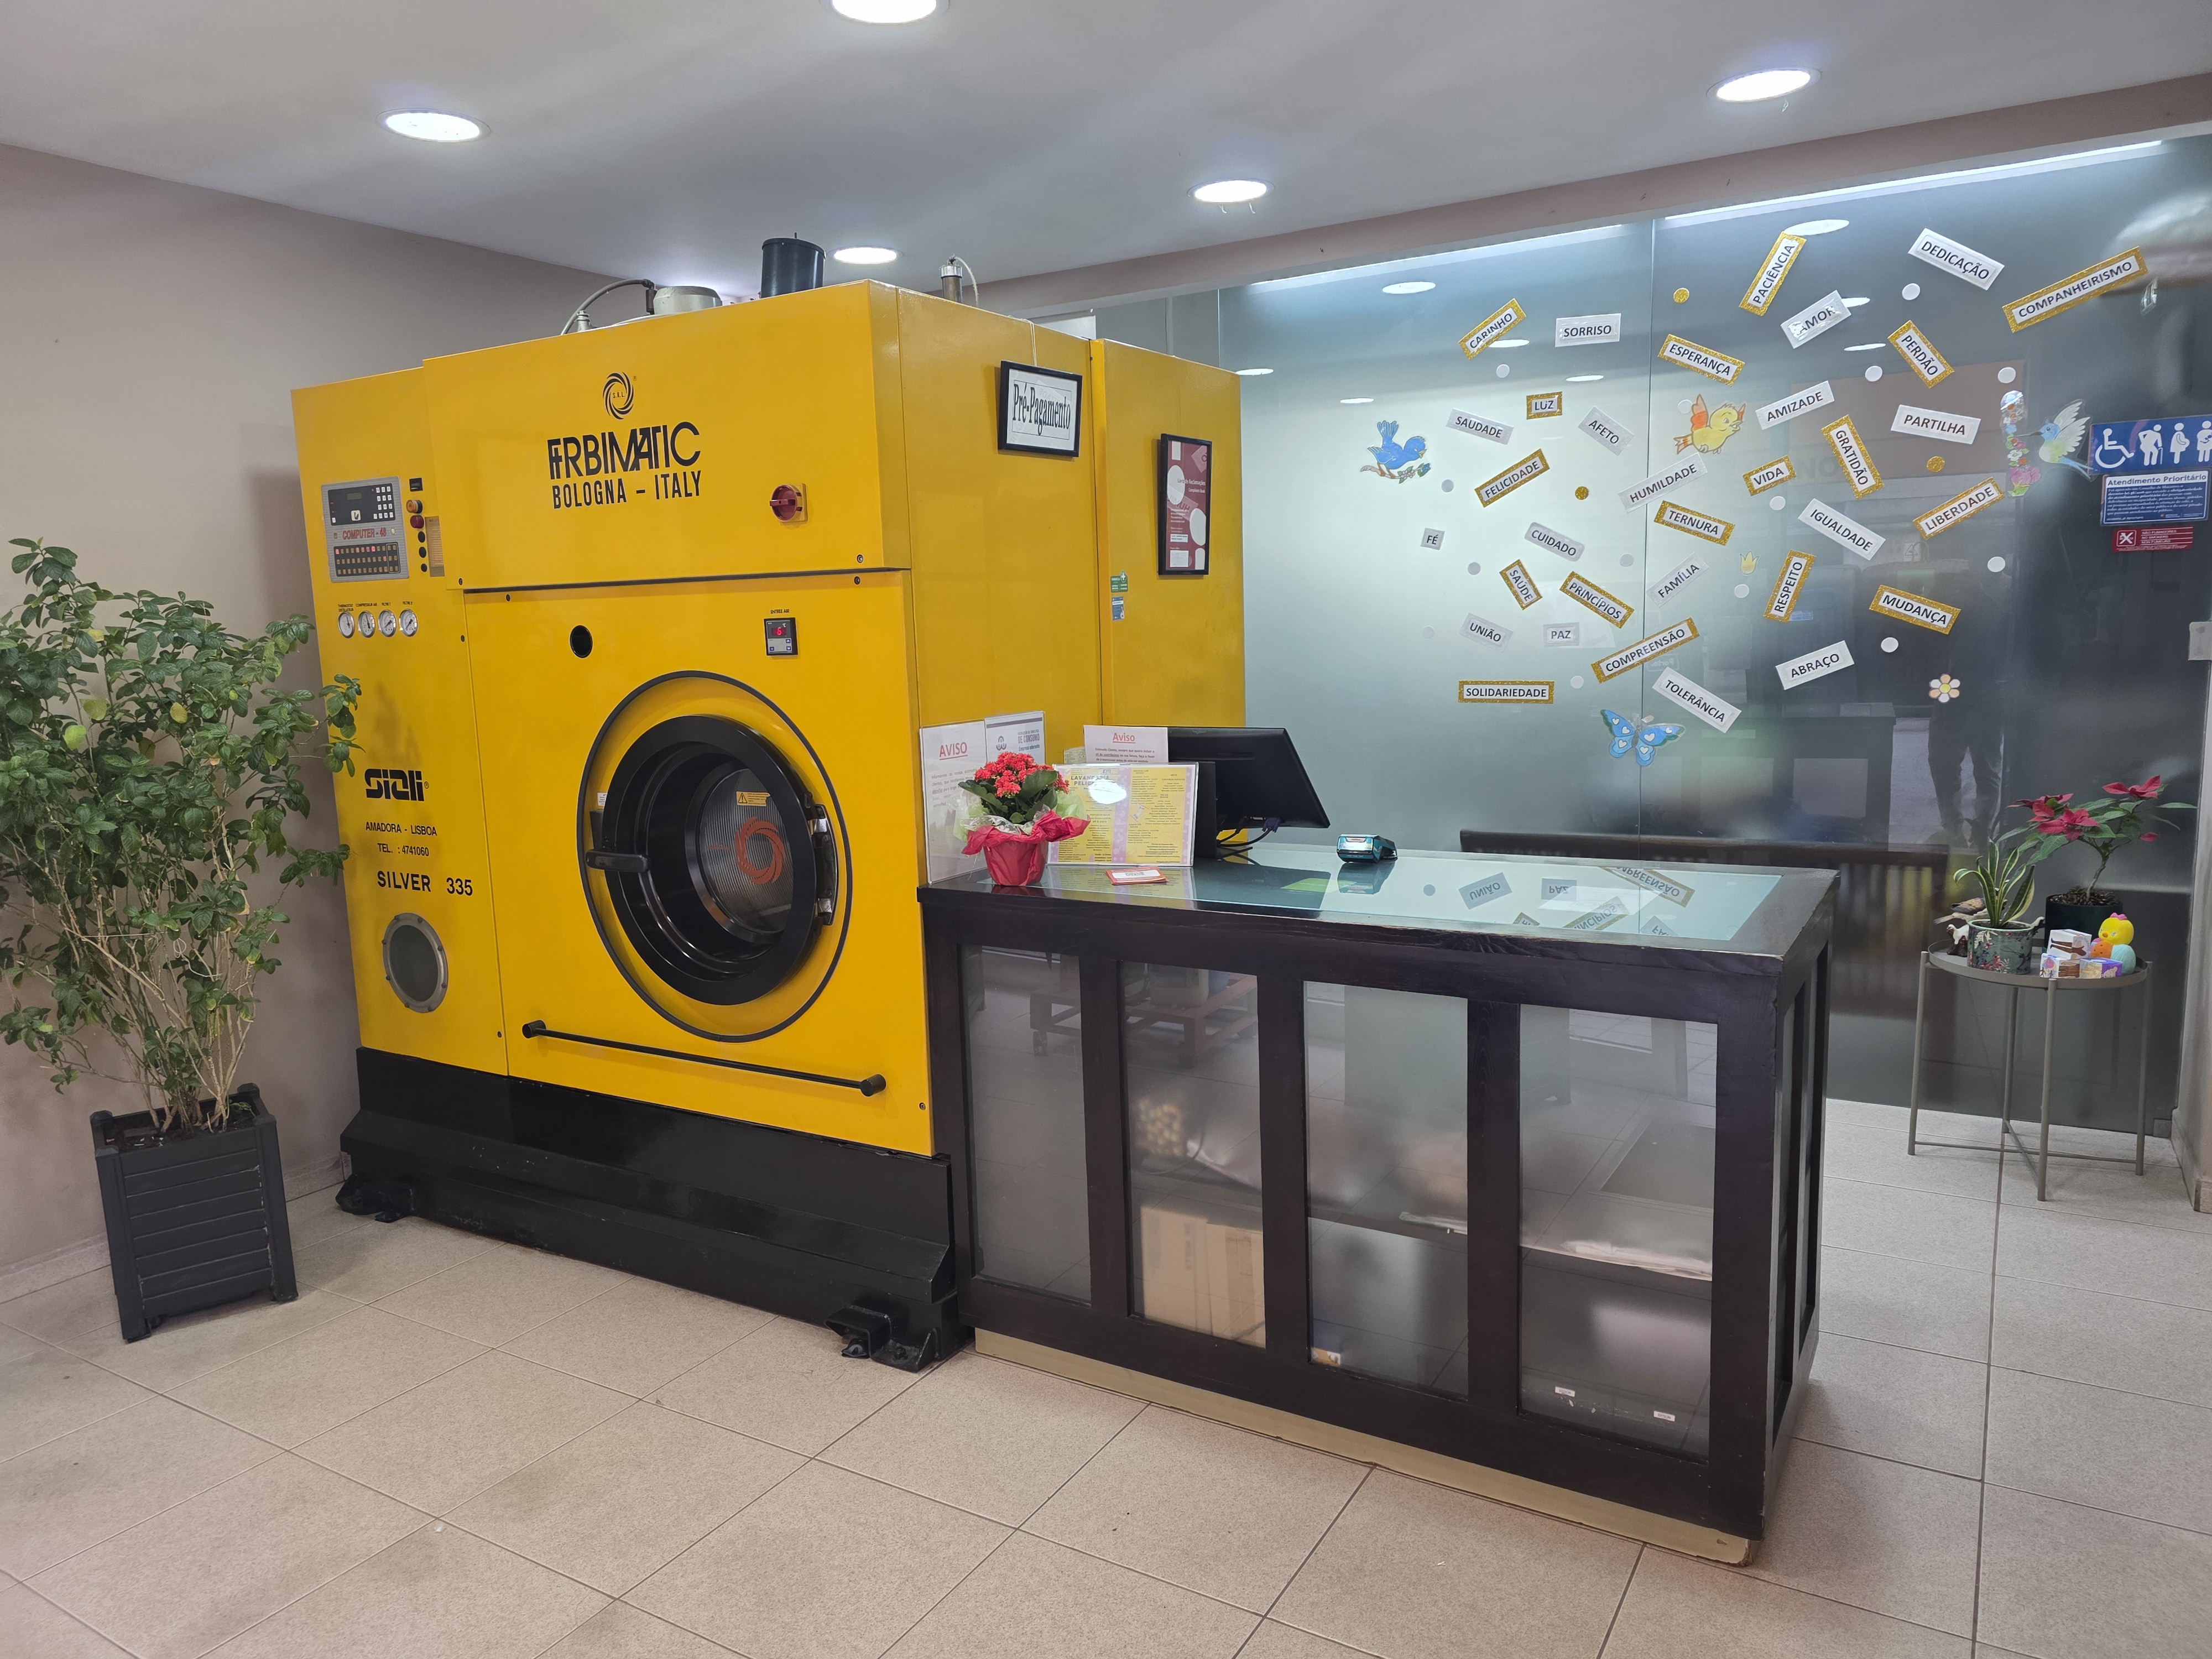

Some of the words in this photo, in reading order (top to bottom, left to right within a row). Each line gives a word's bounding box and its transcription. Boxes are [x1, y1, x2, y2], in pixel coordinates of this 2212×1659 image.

[1753, 245, 1795, 304] PACIÊNCIA
[1921, 241, 1990, 280] DEDICAÇÃO
[2018, 262, 2132, 317] COMPANHEIRISMO
[1470, 313, 1512, 349] CARINHO
[1564, 325, 1611, 337] SORRISO
[1669, 343, 1731, 376] ESPERANÇA
[1901, 335, 1939, 377] PERDÃO
[1013, 383, 1071, 436] Pré-Pagamento
[1535, 400, 1554, 410] LUZ
[1767, 392, 1823, 422] AMIZADE
[1455, 416, 1503, 438] SAUDADE
[1588, 420, 1619, 444] AFETO
[1904, 414, 1965, 435] PARTILHA
[1836, 430, 1869, 486] GRATIDÃO
[552, 478, 627, 509] BOLOGNA
[654, 470, 701, 500] ITALY
[1485, 461, 1540, 498] FELICIDADE
[1630, 464, 1697, 503] HUMILDADE
[1754, 467, 1785, 486] VIDA
[2107, 477, 2161, 486] Atendimento
[2163, 474, 2206, 483] Prioritário
[1669, 510, 1719, 535] TERNURA
[1925, 487, 1994, 531] LIBERDADE
[343, 528, 374, 540] COMPUTER
[1426, 534, 1439, 545] FÉ
[1531, 529, 1577, 556] CUIDADO
[1809, 509, 1873, 551] IGUALDADE
[1510, 570, 1533, 602] SAÚDE
[1658, 564, 1700, 598] FAMÍLIA
[1774, 562, 1803, 613] RESPEITO
[1569, 582, 1621, 619] PRINCÍPIOS
[1882, 594, 1947, 624] MUDANÇA
[1469, 622, 1501, 642] UNIÃO
[1551, 630, 1571, 639] PAZ
[1605, 628, 1686, 672] COMPREENSÃO
[1791, 653, 1840, 678] ABRAÇO
[1466, 687, 1547, 698] SOLIDARIEDADE
[1665, 680, 1725, 722] TOLERÂNCIA
[939, 742, 967, 757] AVISO
[1024, 733, 1040, 743] CONSUMO
[1113, 733, 1135, 741] Aviso
[366, 822, 402, 833] AMADORA
[411, 825, 437, 836] LISBOA
[377, 843, 393, 853] TEL.
[377, 870, 431, 892] SILVER
[446, 877, 473, 896] 335
